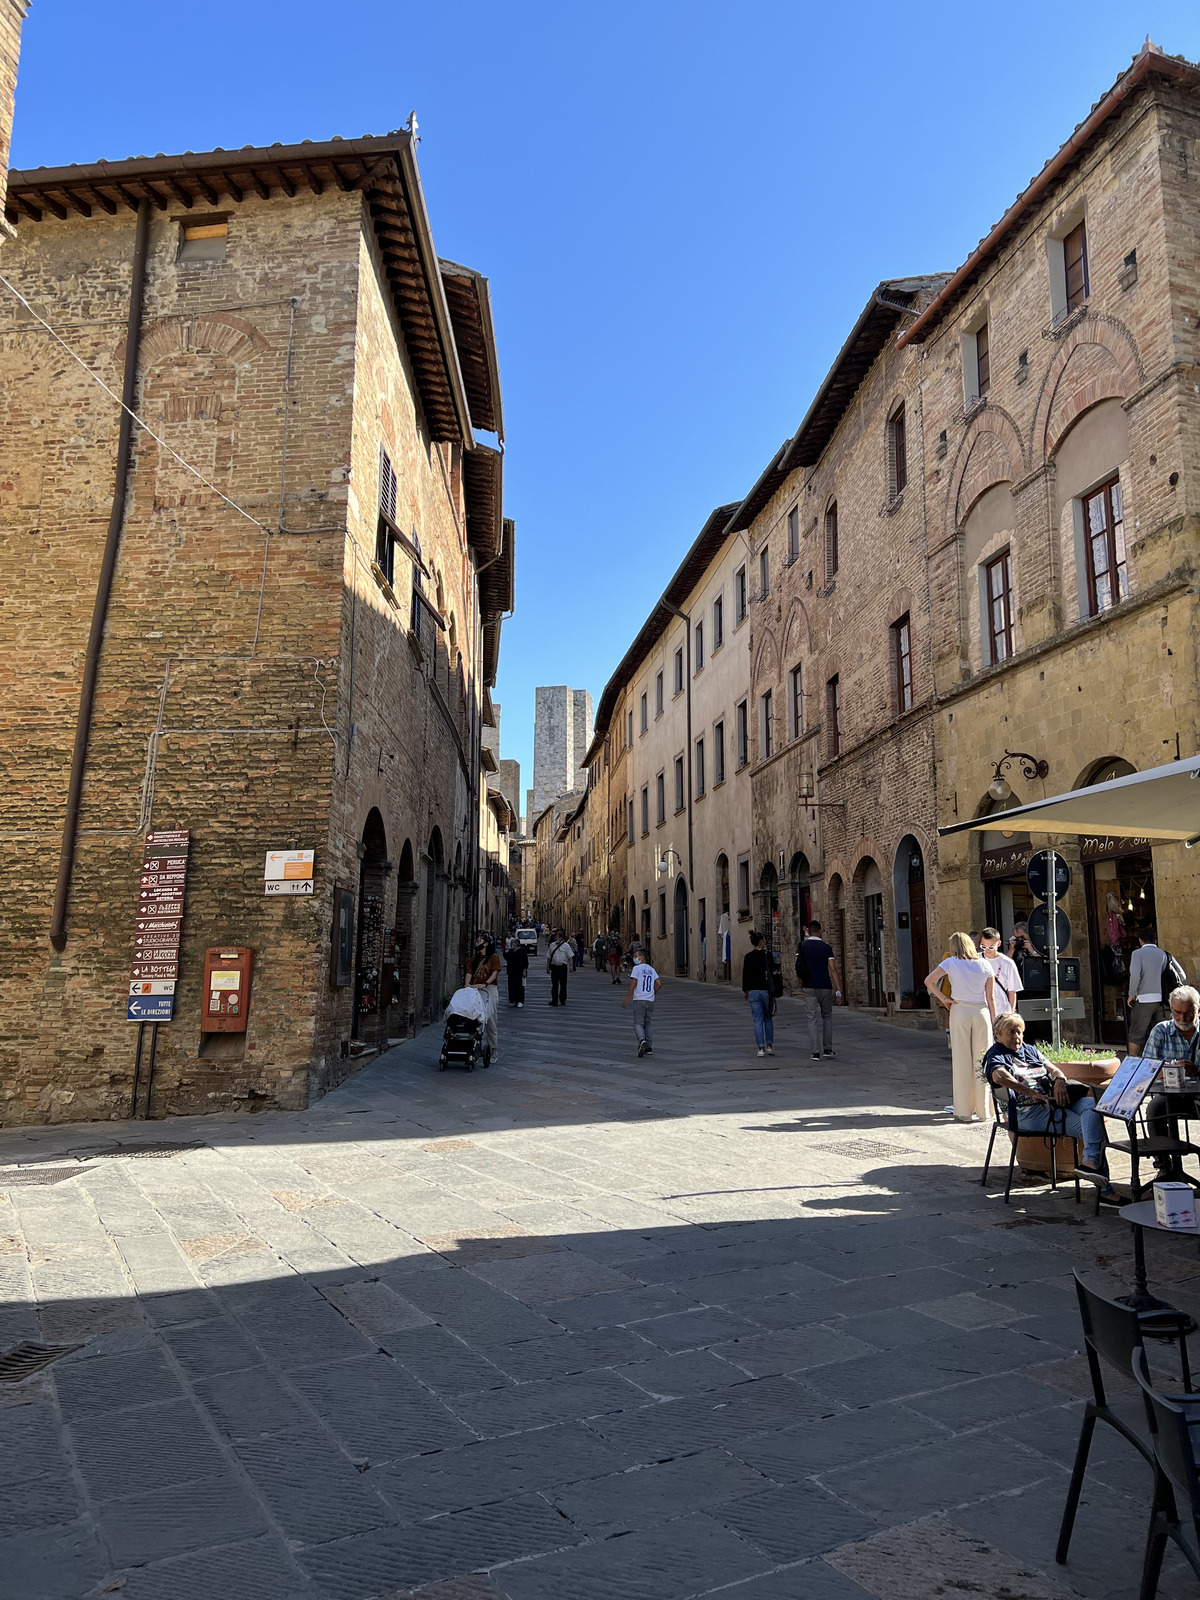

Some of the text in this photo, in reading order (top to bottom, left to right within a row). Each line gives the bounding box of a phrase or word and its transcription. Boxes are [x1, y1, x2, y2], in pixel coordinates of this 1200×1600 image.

[1083, 836, 1113, 855] Melo
[984, 857, 1008, 874] Melo
[642, 975, 652, 992] 10
